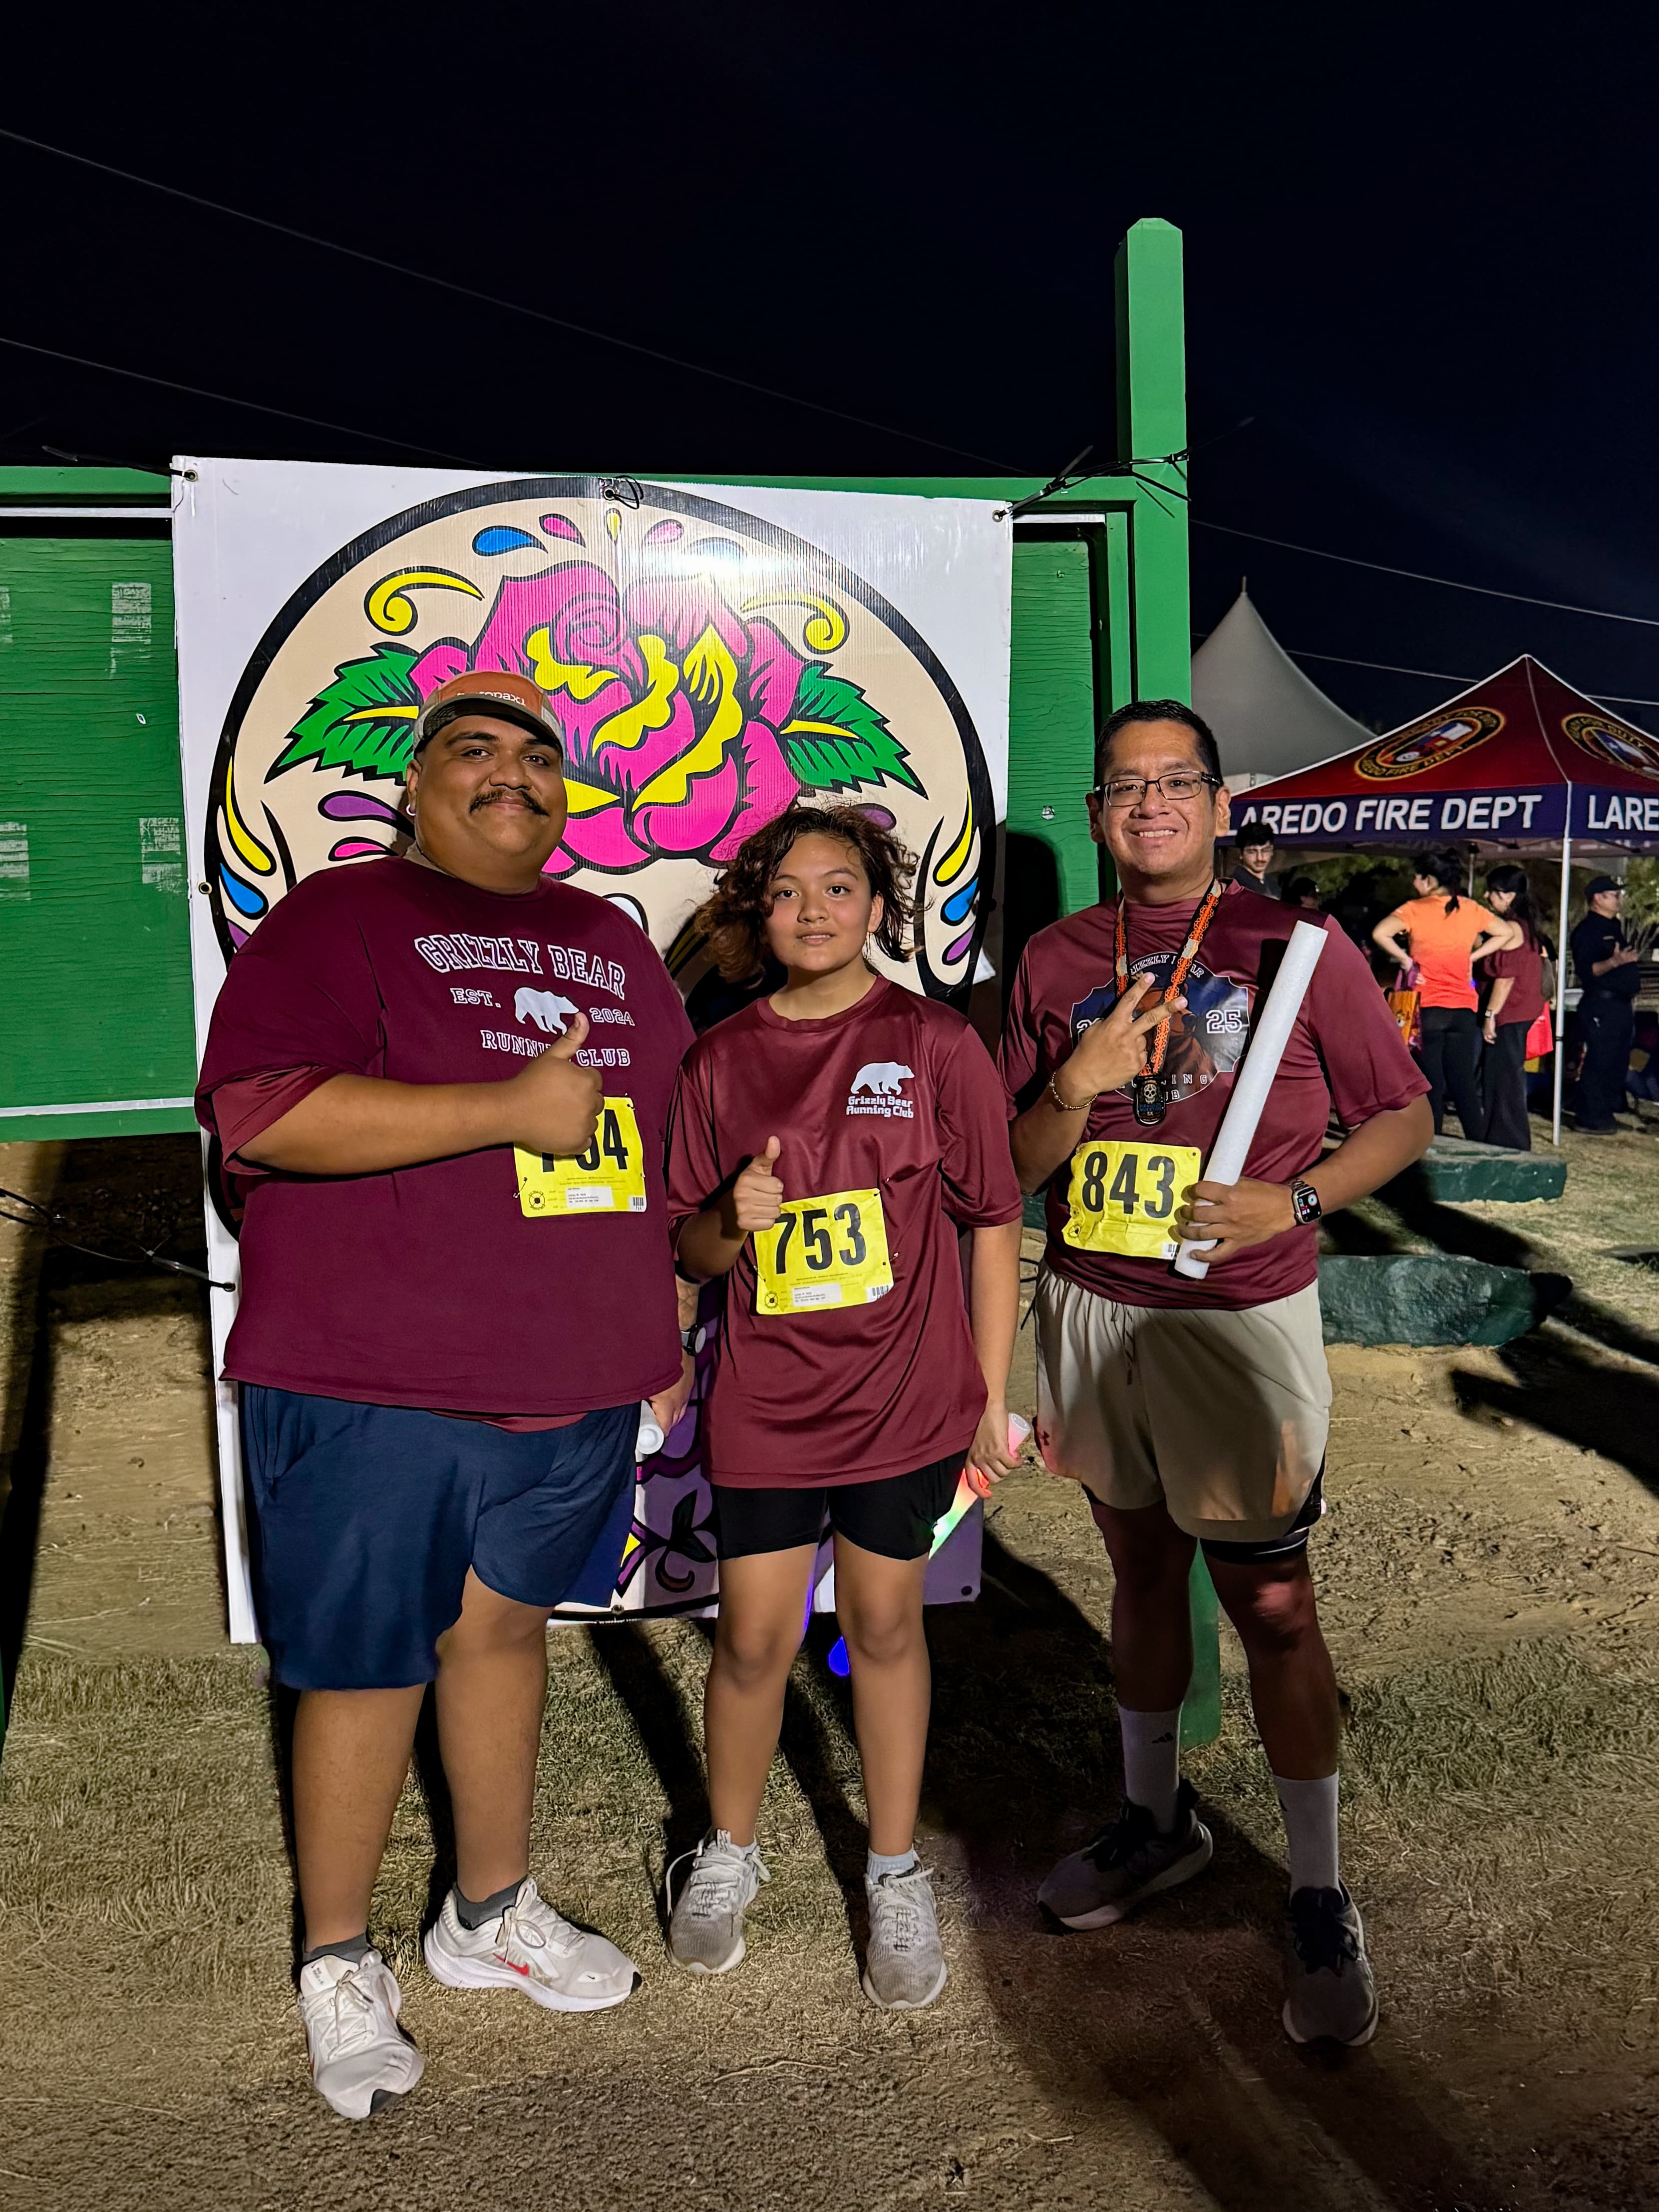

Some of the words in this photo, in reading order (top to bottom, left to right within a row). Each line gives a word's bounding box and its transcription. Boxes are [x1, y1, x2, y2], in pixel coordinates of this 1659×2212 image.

[1355, 799, 1433, 831] FIRE
[1441, 795, 1543, 830] DEPT
[1588, 795, 1659, 831] LARE
[414, 934, 544, 974] GRIZZLY
[547, 944, 626, 1000] BEAR
[450, 987, 501, 1008] EST.
[590, 1007, 635, 1026] 2024
[1206, 1009, 1243, 1034] 25
[576, 1048, 631, 1066] CLUB
[846, 1105, 891, 1117] Running
[893, 1106, 914, 1118] Club
[848, 1096, 886, 1107] Grizzly
[887, 1096, 913, 1108] Bear
[1082, 1151, 1175, 1218] 843
[775, 1203, 866, 1274] 753
